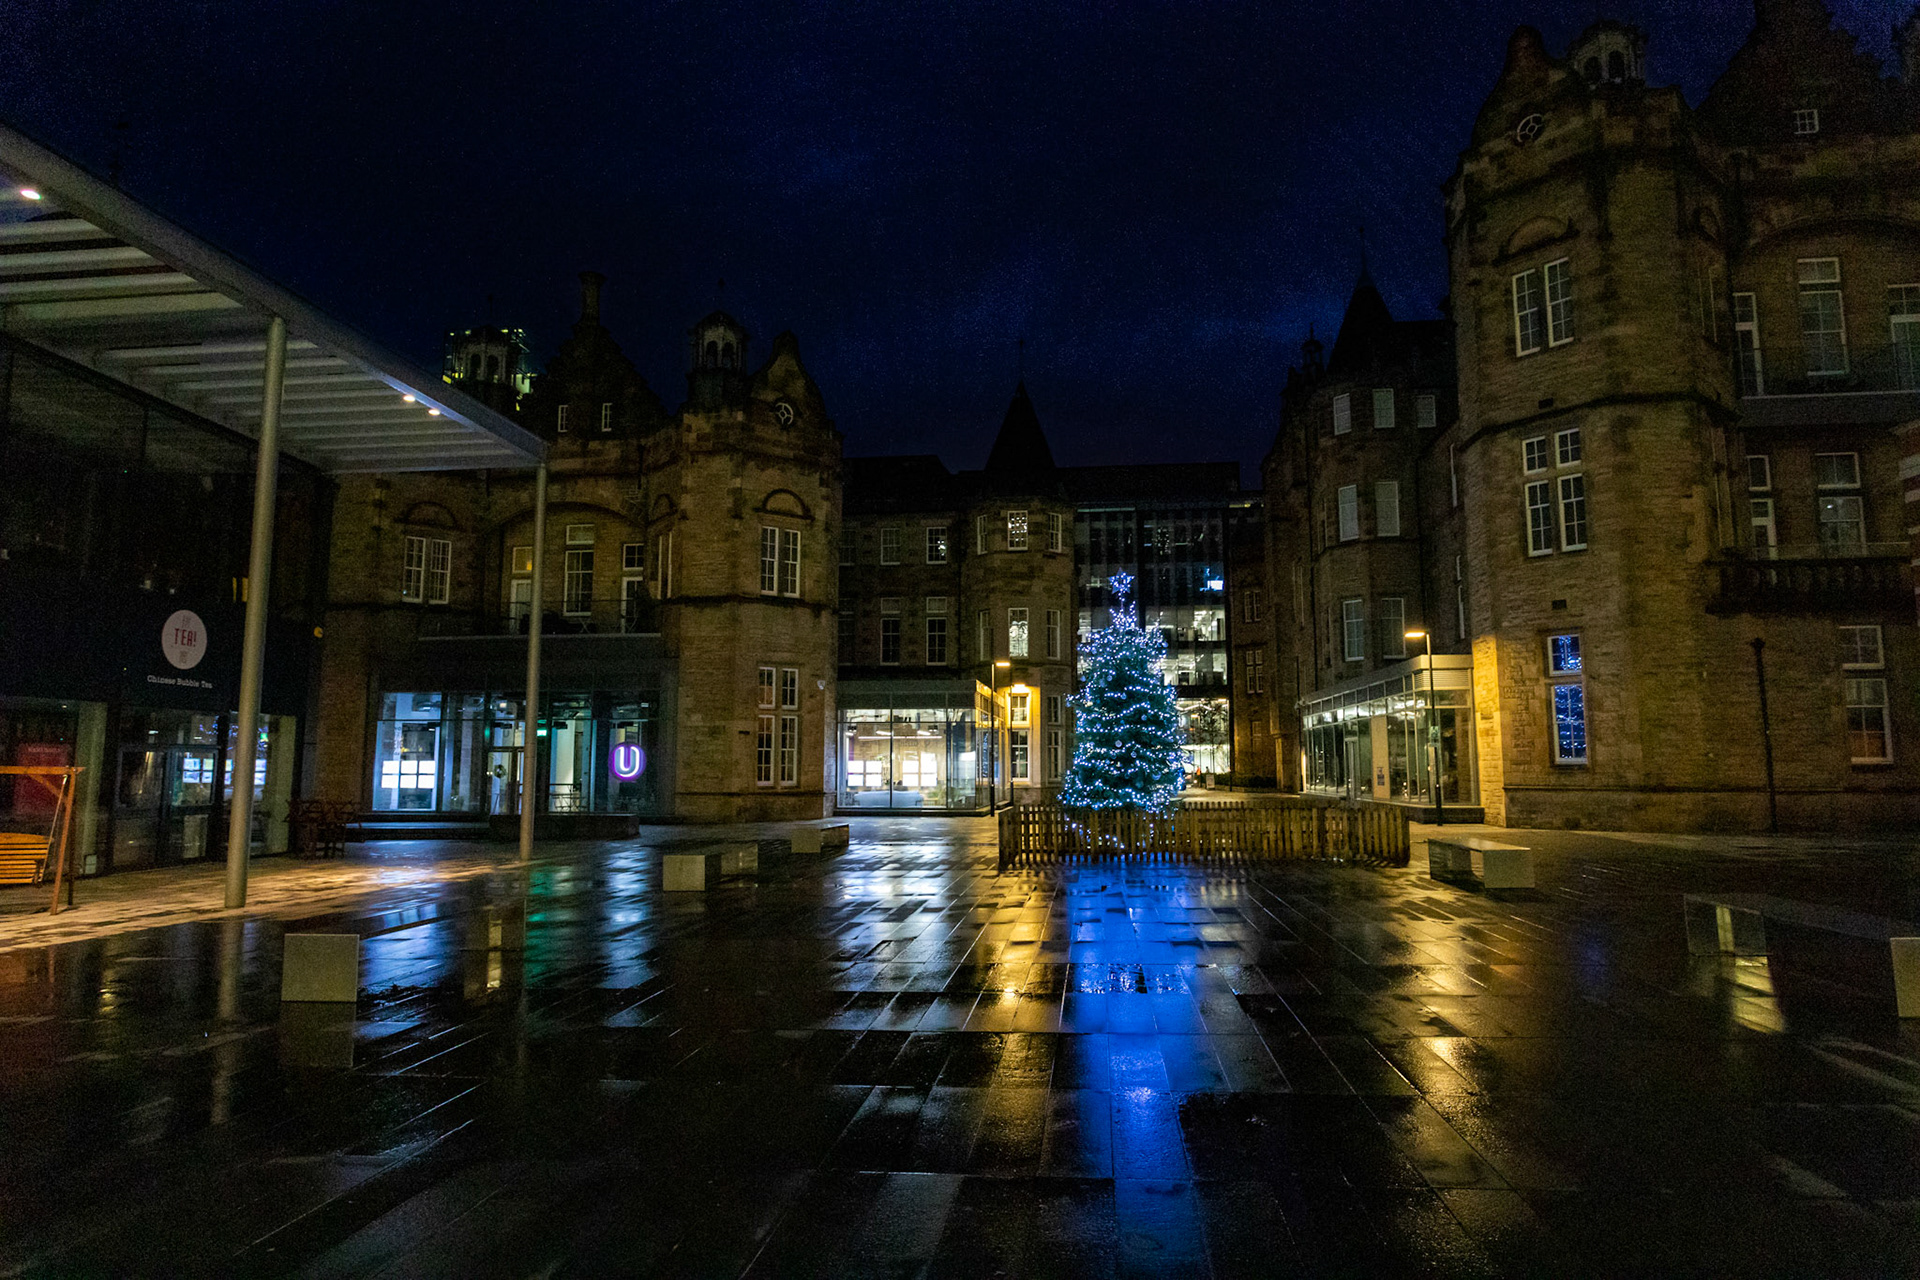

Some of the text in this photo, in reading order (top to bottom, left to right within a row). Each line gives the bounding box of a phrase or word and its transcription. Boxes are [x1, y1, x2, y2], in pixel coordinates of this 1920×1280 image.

[174, 628, 197, 647] TEA!
[147, 675, 213, 689] Chinese Bubble Tea
[613, 745, 641, 778] U
